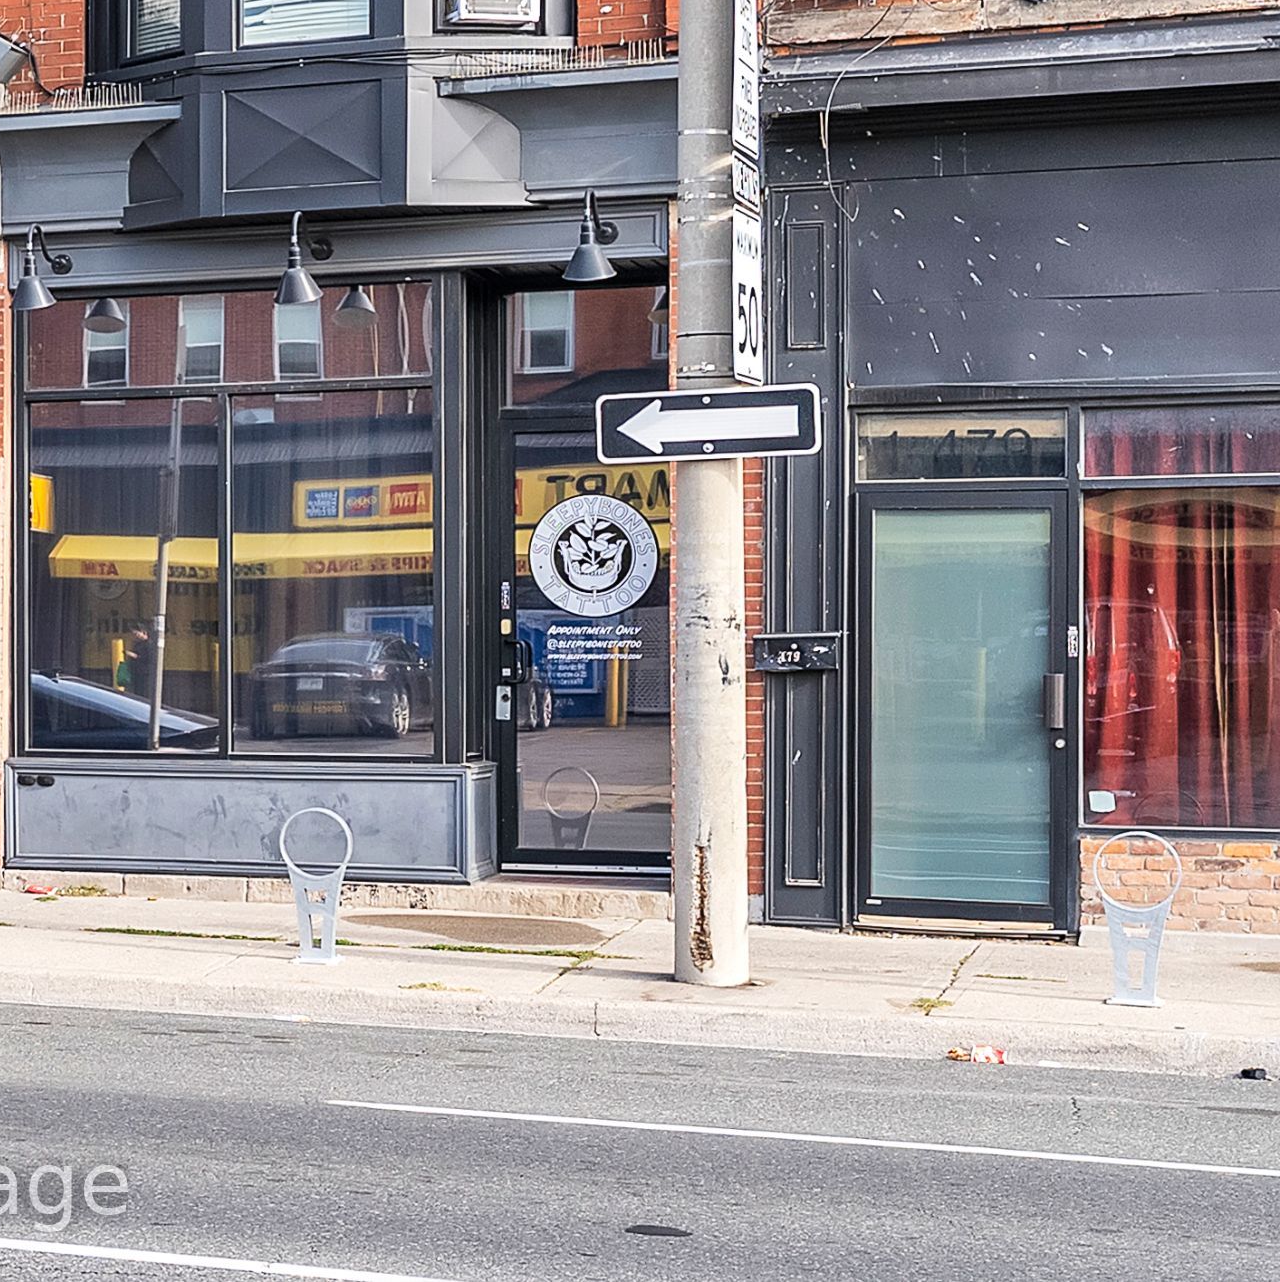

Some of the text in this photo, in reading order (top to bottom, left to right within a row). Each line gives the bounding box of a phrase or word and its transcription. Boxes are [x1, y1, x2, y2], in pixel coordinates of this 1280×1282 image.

[738, 283, 759, 358] 50
[533, 497, 655, 556] SLEEPYBONES
[543, 575, 646, 613] TATTOO
